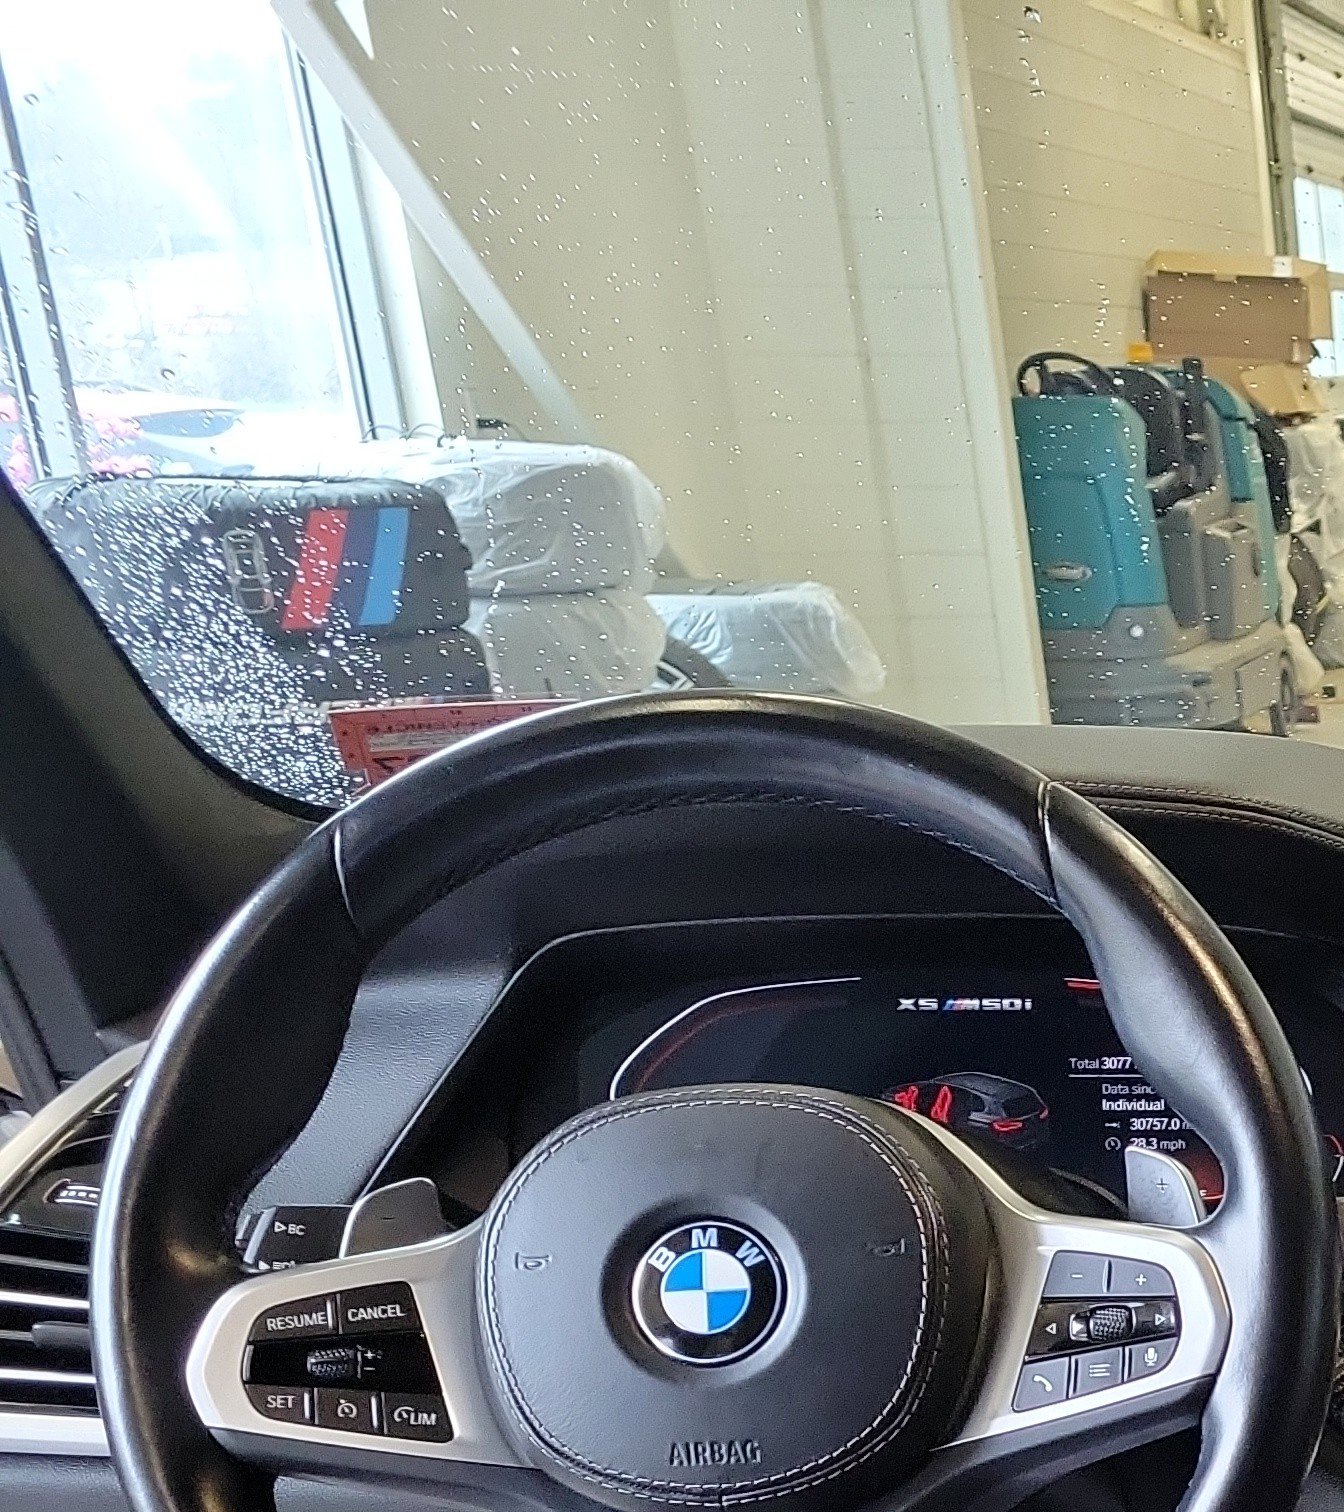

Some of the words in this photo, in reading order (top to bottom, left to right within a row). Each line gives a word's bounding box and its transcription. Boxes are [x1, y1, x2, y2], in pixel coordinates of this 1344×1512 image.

[896, 998, 939, 1011] X5
[1069, 1058, 1099, 1069] Total
[1101, 1057, 1138, 1070] 3077
[1102, 1084, 1129, 1094] Data
[1102, 1099, 1165, 1111] Individual
[1129, 1118, 1181, 1131] 30757.0
[1160, 1139, 1186, 1151] mph
[647, 1226, 768, 1273] BMW
[346, 1304, 408, 1322] CANCEL
[265, 1311, 329, 1332] RESUME
[266, 1395, 297, 1408] SET
[408, 1412, 437, 1426] LIM
[668, 1440, 763, 1467] AIRBAG
